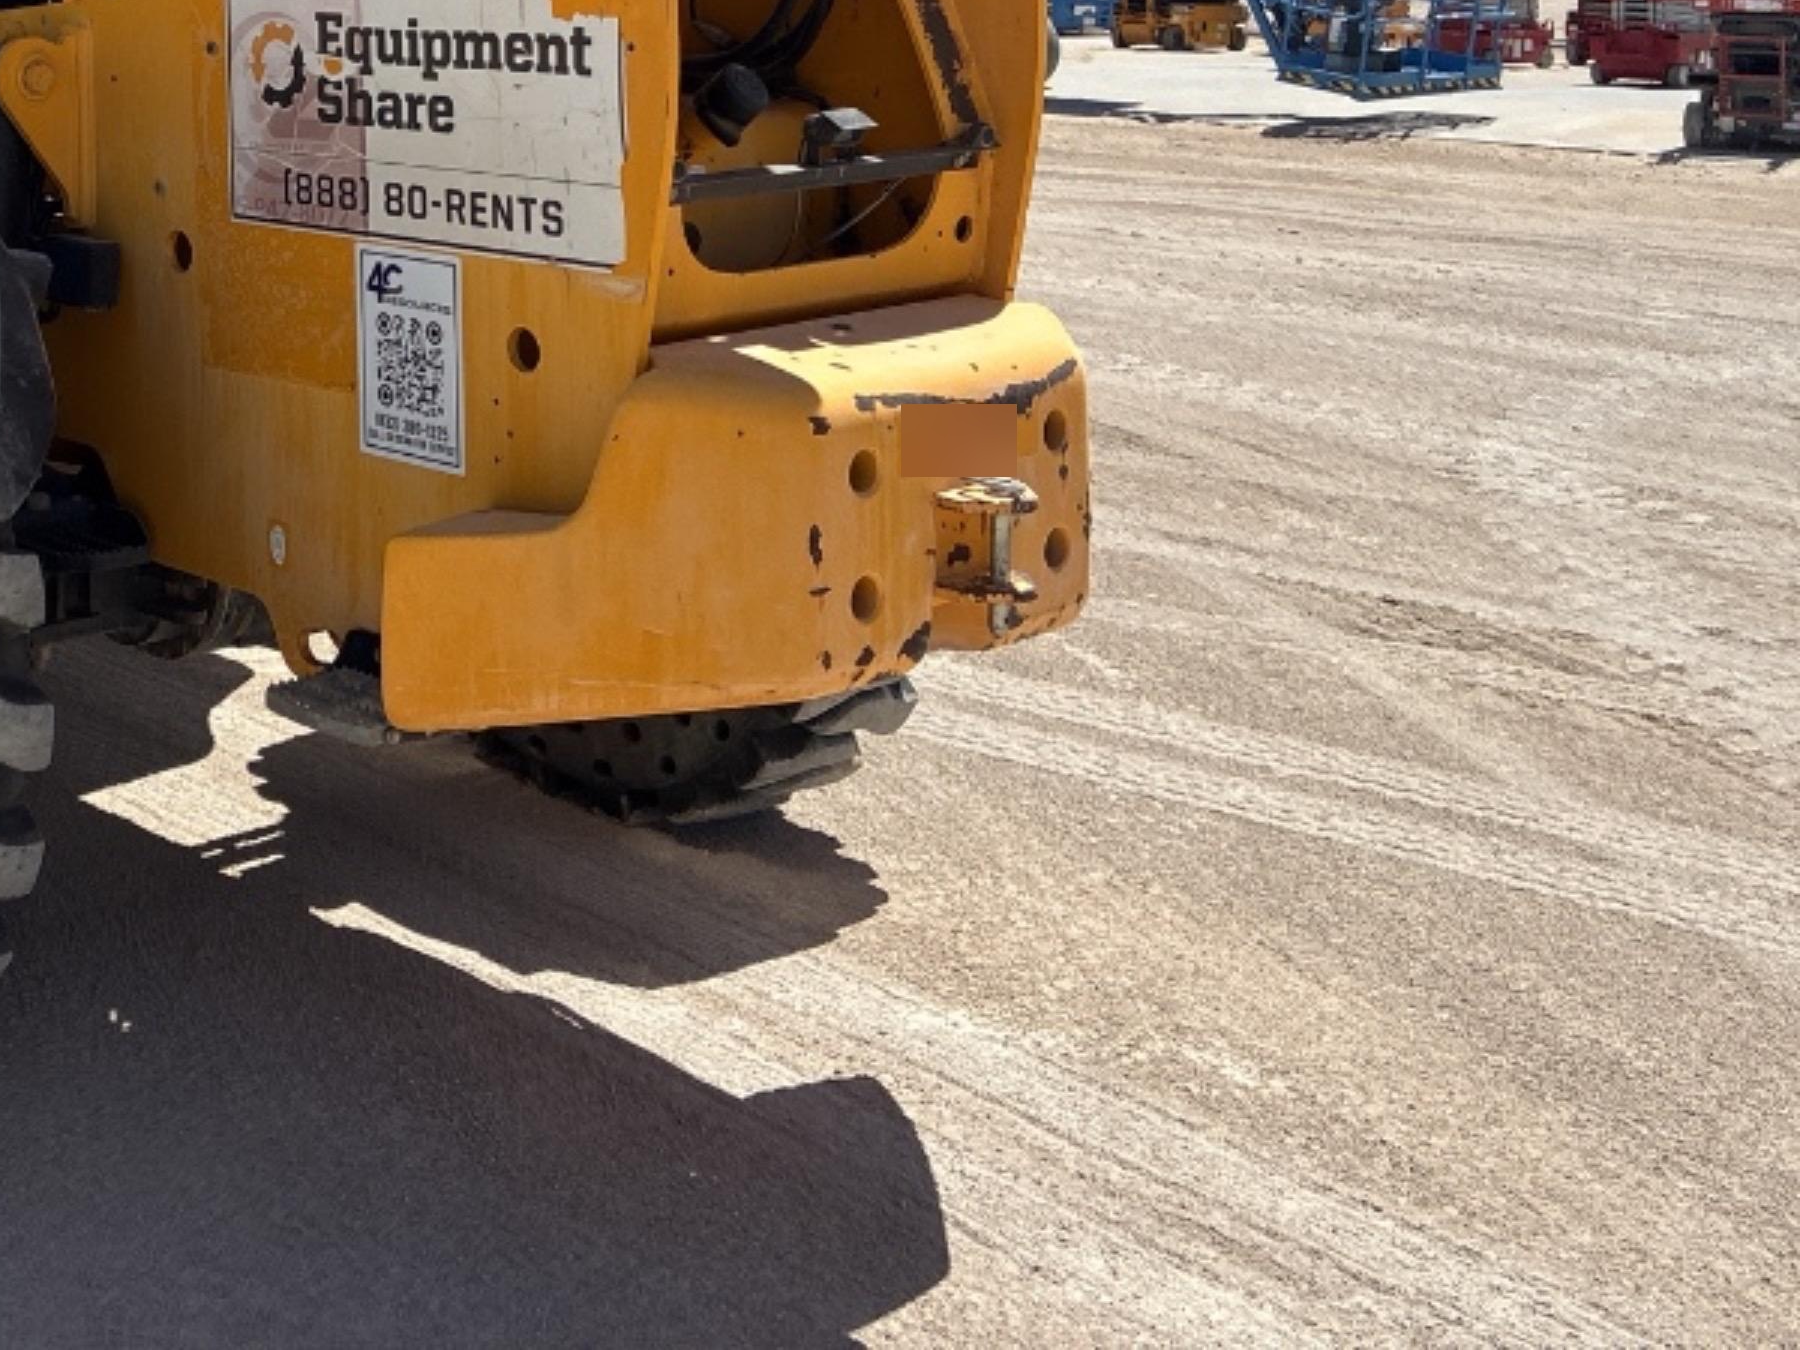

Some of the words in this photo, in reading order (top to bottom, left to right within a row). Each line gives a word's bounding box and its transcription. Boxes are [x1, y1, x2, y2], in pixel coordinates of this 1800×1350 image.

[314, 11, 593, 82] Equipment
[316, 76, 455, 133] Share
[283, 167, 370, 217] (888)
[383, 182, 565, 238] 80-RENTS
